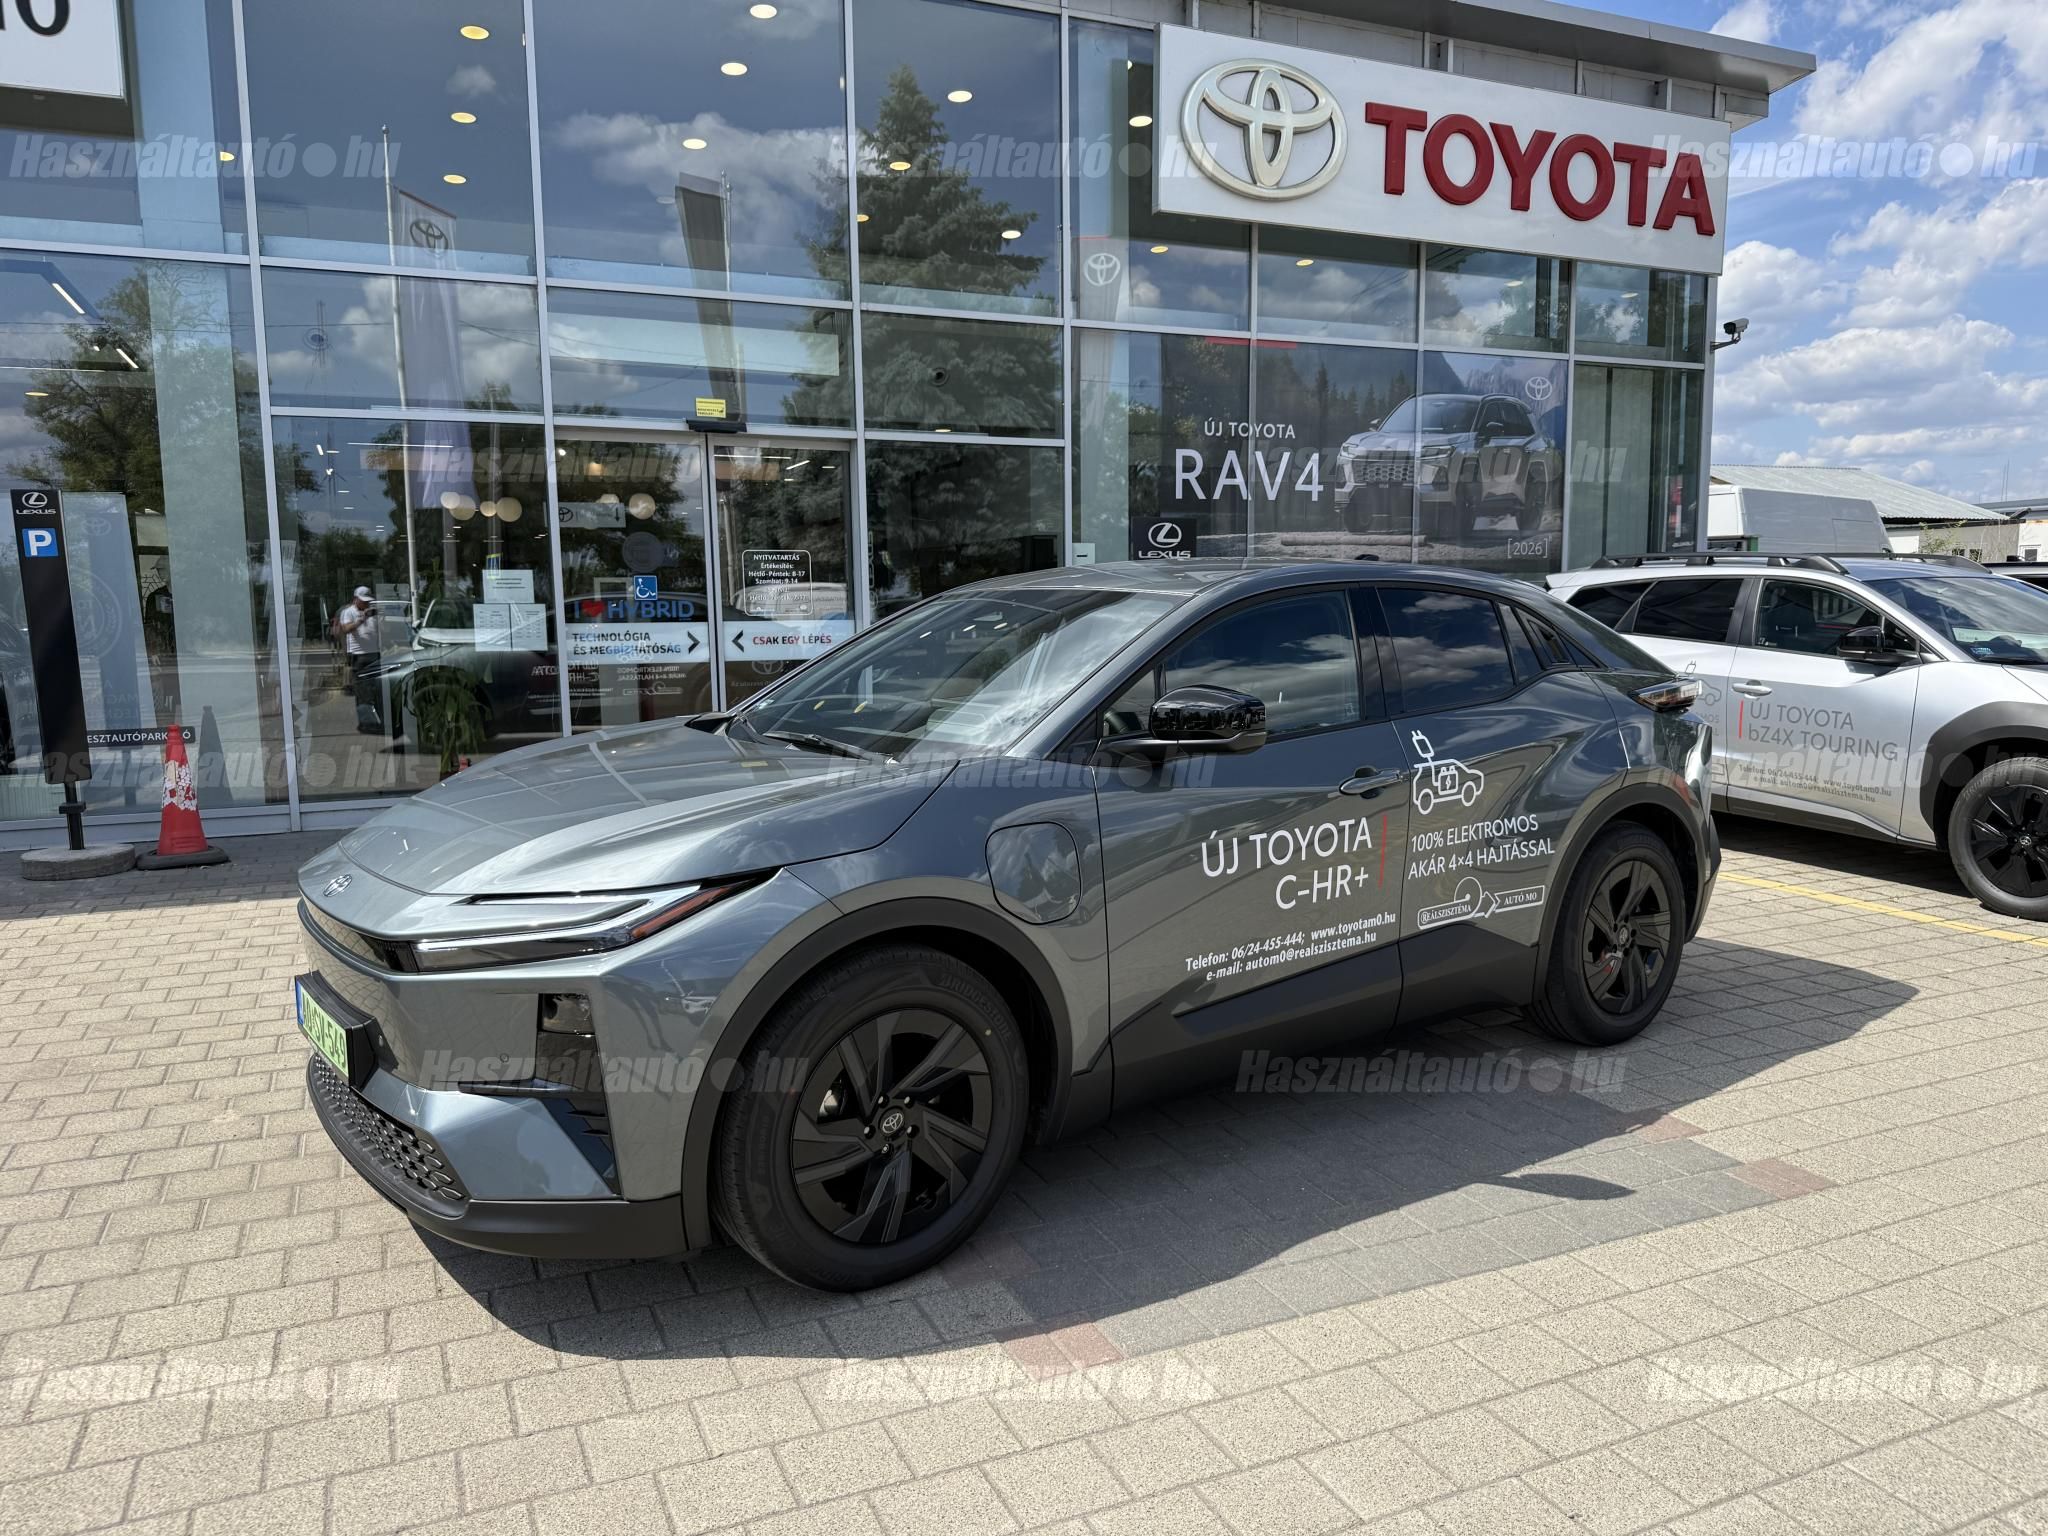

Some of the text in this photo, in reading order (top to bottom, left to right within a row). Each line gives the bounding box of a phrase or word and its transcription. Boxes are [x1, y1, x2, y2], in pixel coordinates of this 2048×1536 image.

[1365, 102, 1715, 236] TOYOTA
[1204, 419, 1296, 439] ÚJ TOYOTA
[1175, 449, 1324, 502] RAV4
[28, 530, 52, 556] P
[753, 553, 800, 561] NYITVATARTÁS
[1138, 550, 1191, 560] LEXUS
[607, 600, 695, 619] HYBRID
[571, 630, 651, 643] TECHNOLÓGIA
[573, 642, 682, 656] ÉS MEGBÍZHATÓSÁG
[752, 633, 832, 645] CSAK EGY LÉPÉS
[1751, 698, 1854, 731] ÚJ TOYOTA
[87, 729, 191, 744] ESZTAUTÓPARKÓ
[1748, 723, 1898, 761] bZ4X TOURING
[1201, 817, 1373, 878] ÚJ TOYOTA
[1411, 813, 1539, 853] 100% ELEKTROMOS
[1408, 853, 1446, 880] AKÁR
[1476, 837, 1556, 867] HAJTÁSSAL
[1275, 863, 1370, 910] C-HR+
[1503, 891, 1525, 906] AUTÓ
[1185, 911, 1397, 972] Telefon: 06/24-455-444; www.toyotam0.hu
[1206, 931, 1378, 981] e-mail: autom0@realszisztema.hu
